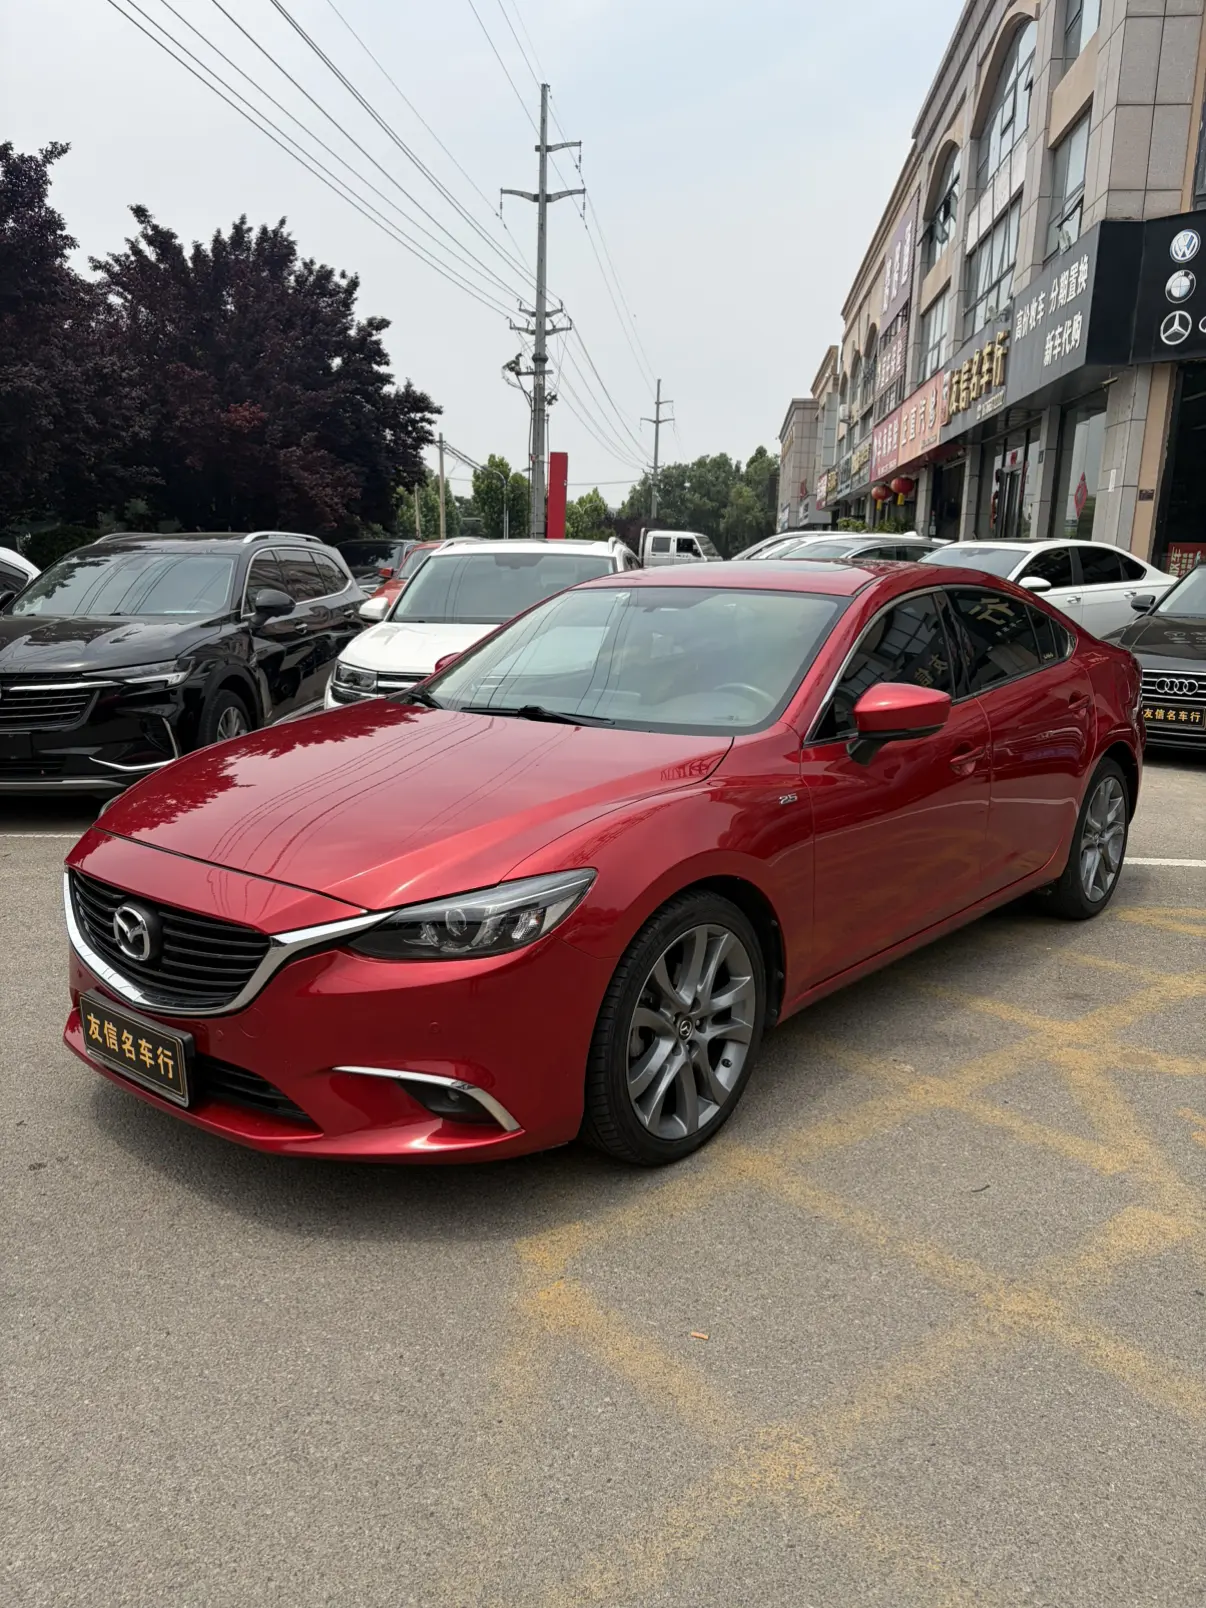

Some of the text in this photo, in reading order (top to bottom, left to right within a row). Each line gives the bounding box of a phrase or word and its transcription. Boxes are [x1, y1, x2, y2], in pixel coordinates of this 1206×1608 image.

[1049, 253, 1089, 314] 分期置换
[1043, 310, 1083, 366] 新车代购
[1143, 708, 1201, 722] 友信名车行
[87, 1012, 174, 1079] 友信名车行
